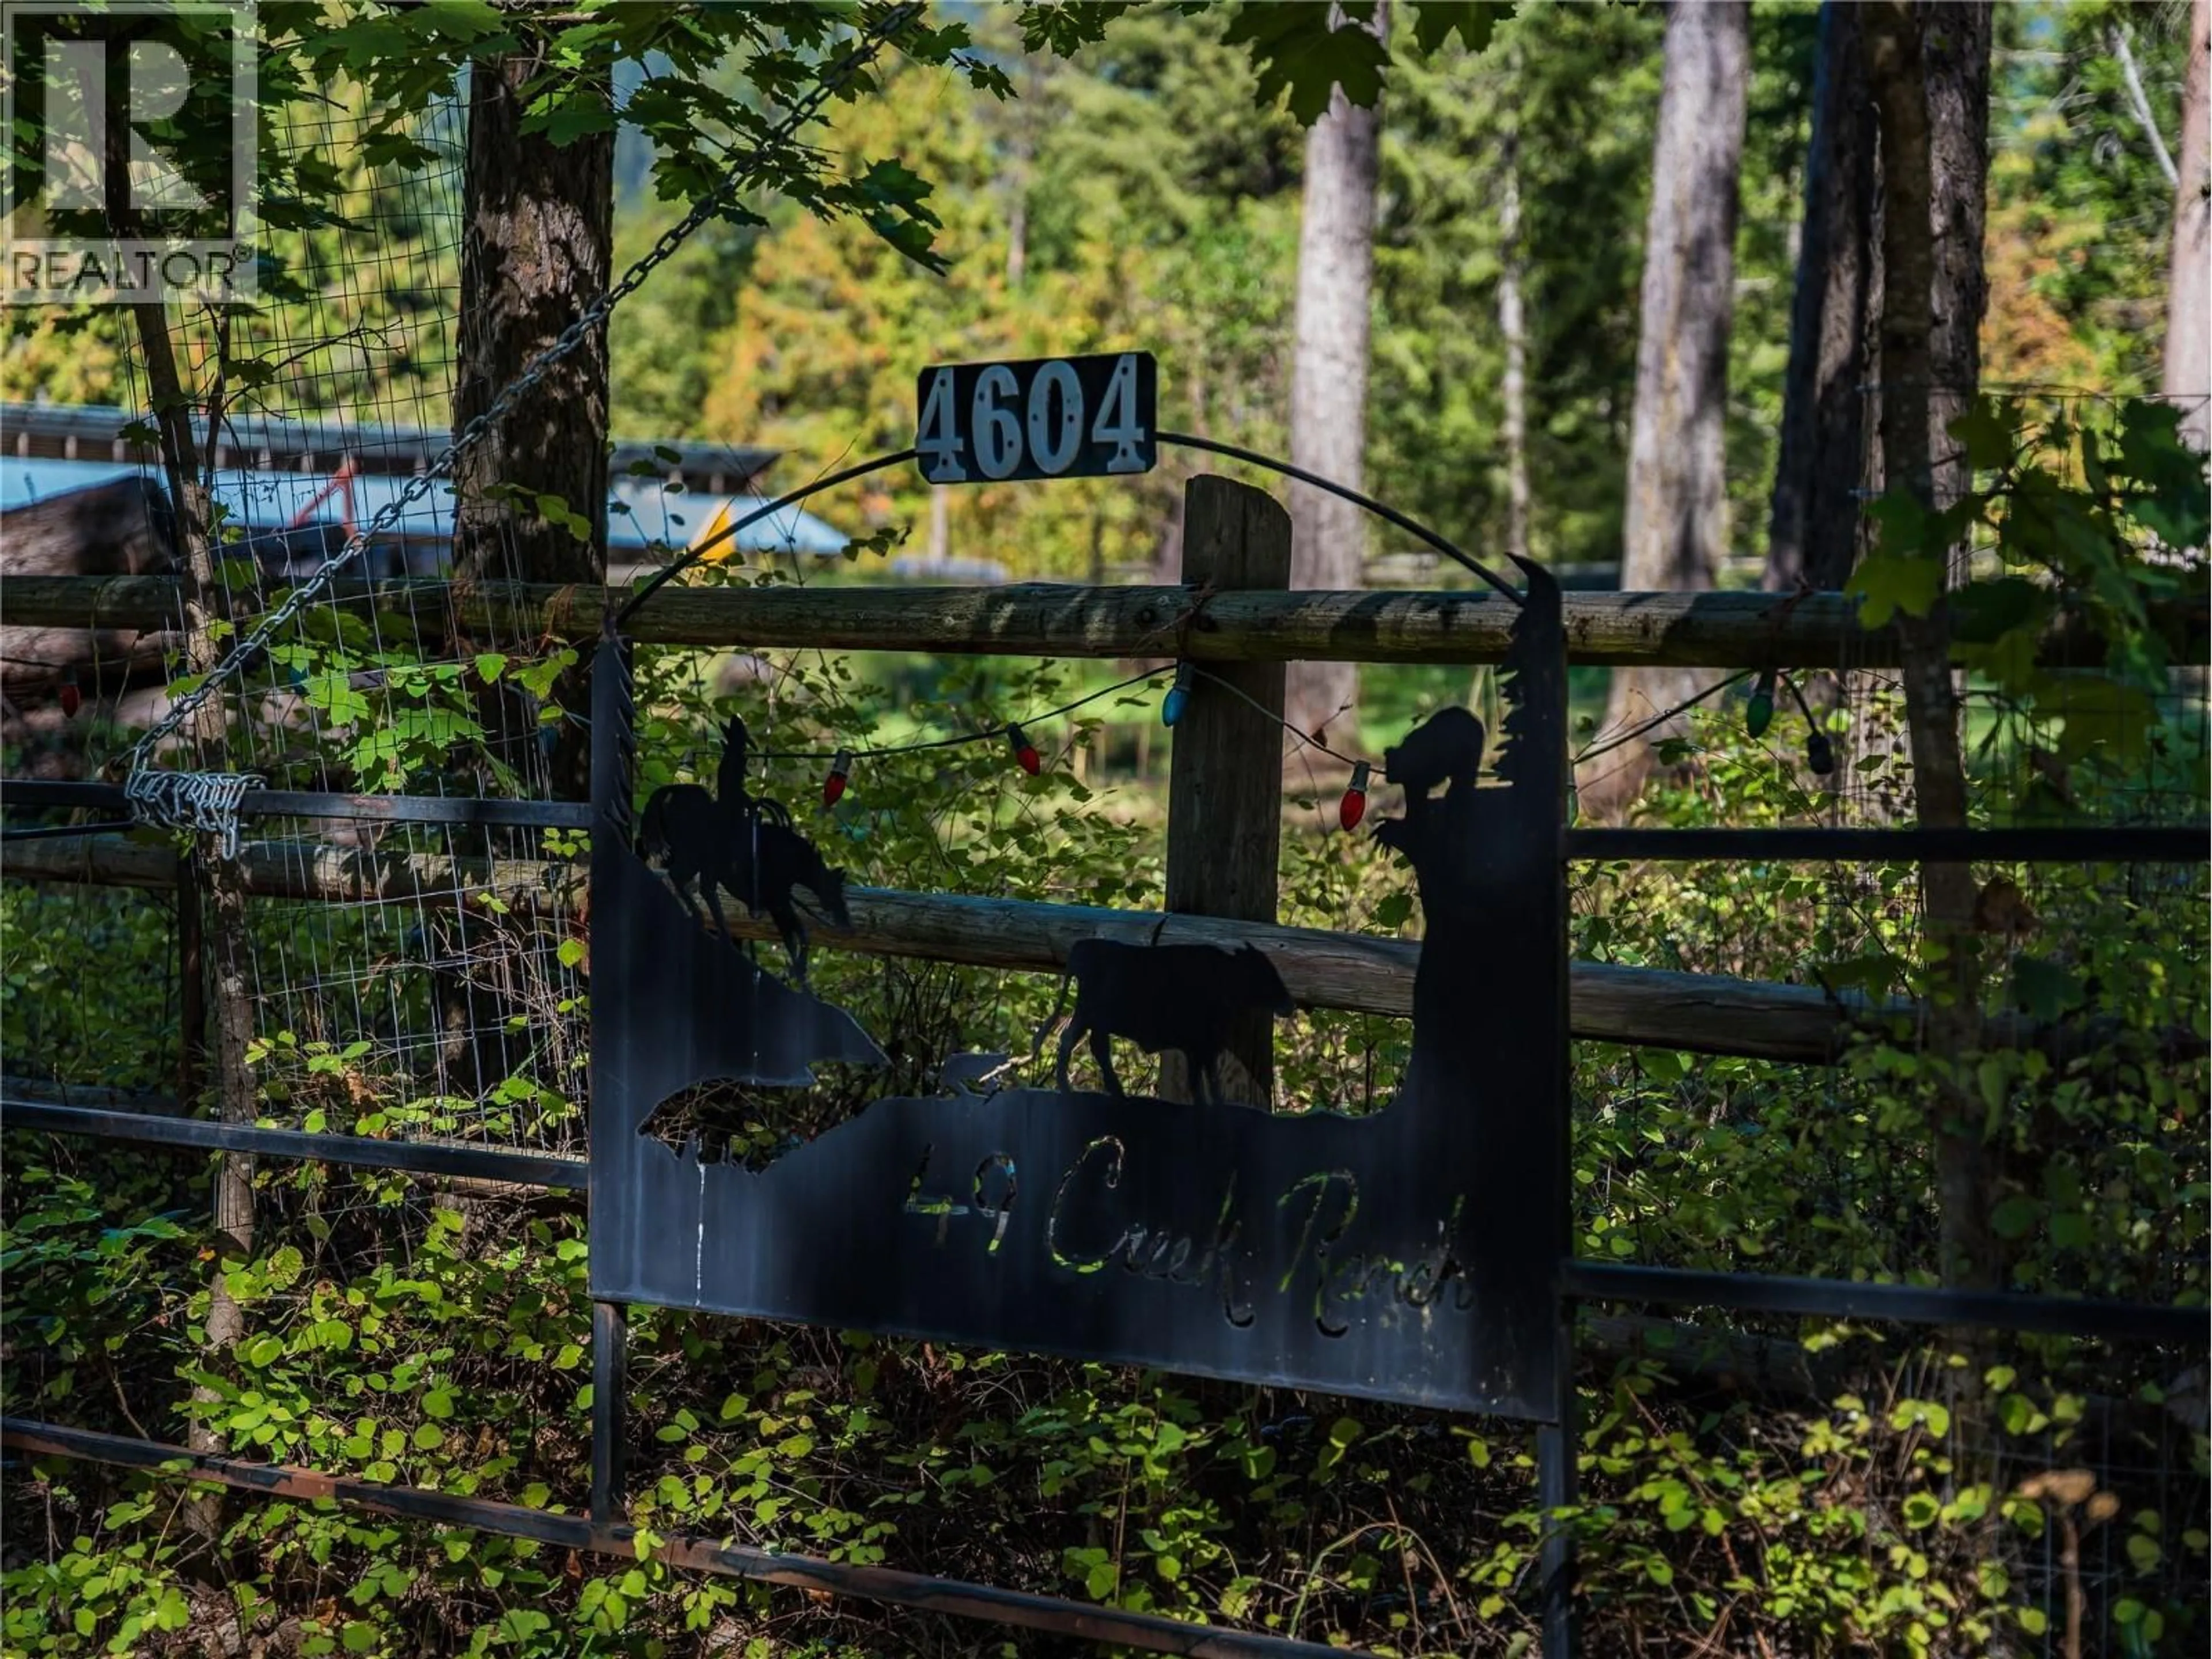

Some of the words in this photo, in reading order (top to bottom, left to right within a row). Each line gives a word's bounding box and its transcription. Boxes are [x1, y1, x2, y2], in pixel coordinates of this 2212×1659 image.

[916, 354, 1146, 482] 4604
[903, 1143, 1017, 1256] 49
[1047, 1134, 1256, 1330] Creek
[1277, 1167, 1476, 1338] Ranch
